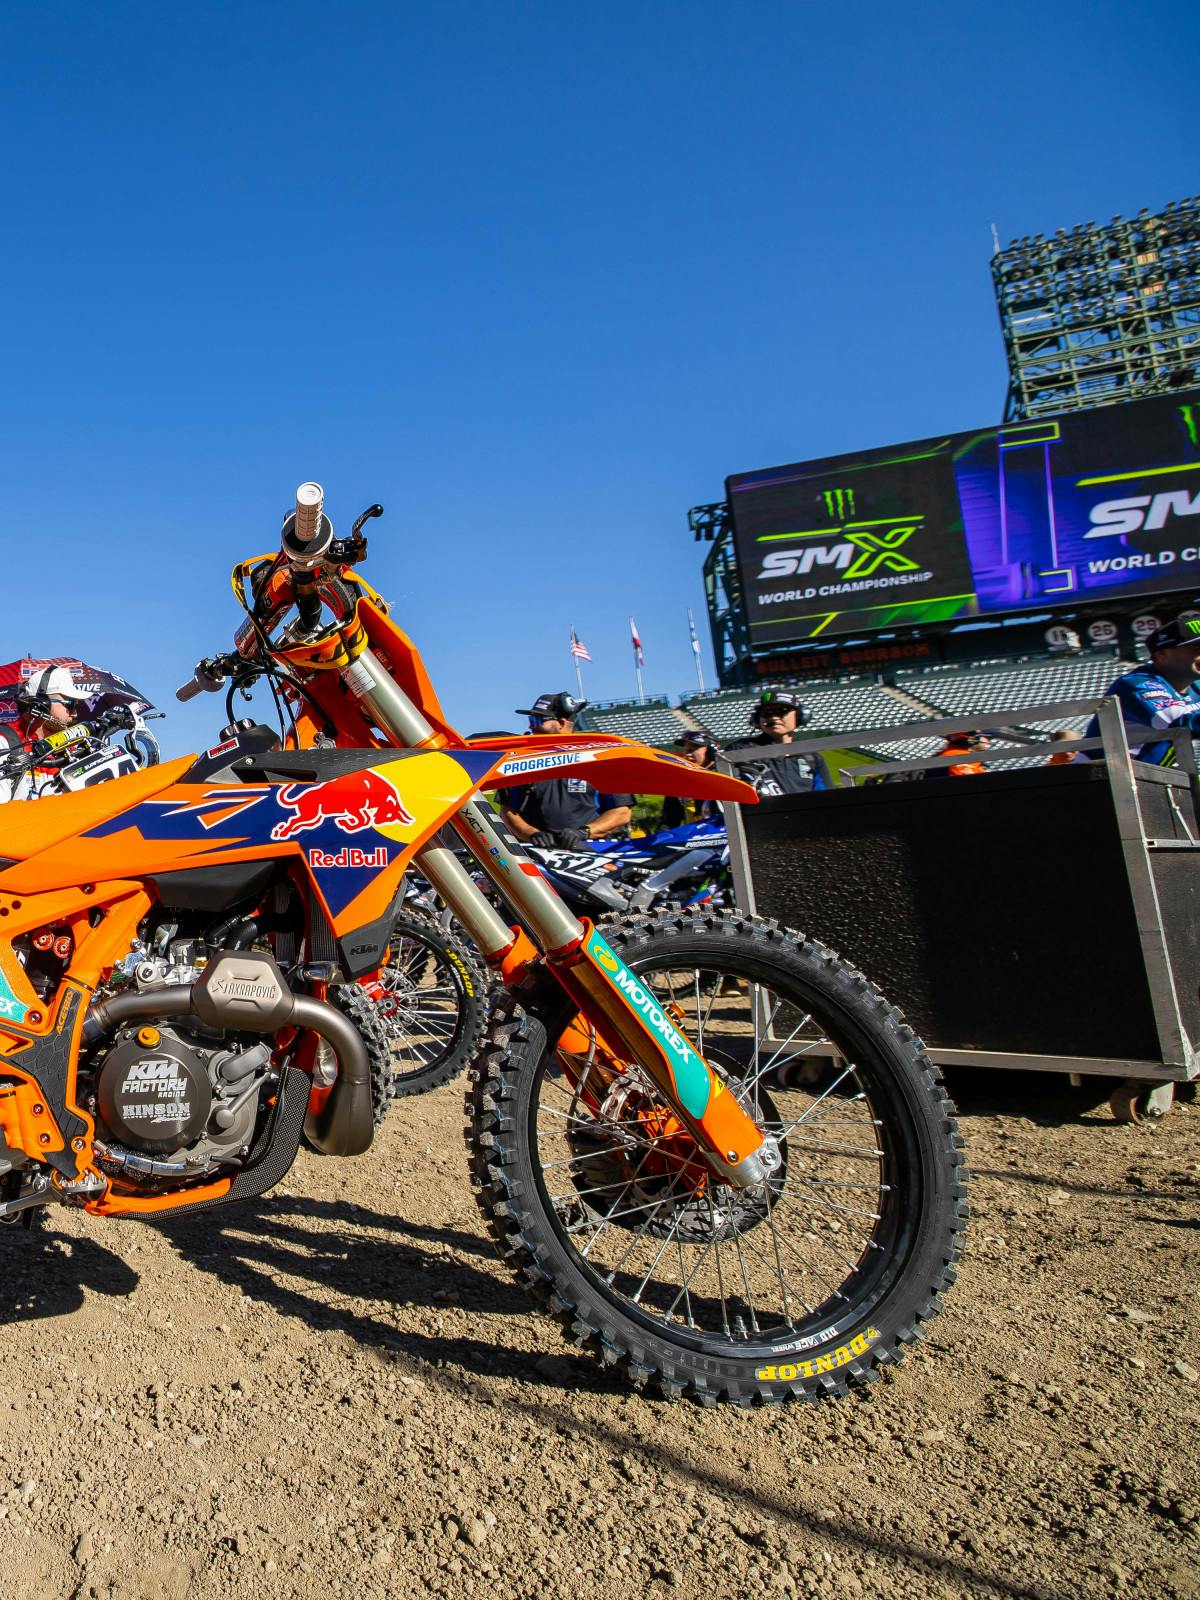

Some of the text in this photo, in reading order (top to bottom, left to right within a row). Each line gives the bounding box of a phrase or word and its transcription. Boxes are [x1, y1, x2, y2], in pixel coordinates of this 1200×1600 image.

[757, 526, 921, 579] SMX
[1088, 551, 1176, 573] WORLD
[758, 571, 933, 605] WORLD CHAMPIONSHIP
[503, 753, 582, 774] PROGRESSIVE
[462, 808, 486, 834] XACT
[309, 847, 388, 868] Red Bull
[350, 944, 379, 955] KTM
[615, 968, 694, 1065] MOTOREX
[127, 1060, 179, 1080] KTM
[121, 1078, 188, 1094] FACTORY
[122, 1102, 191, 1117] HINSON
[755, 1333, 870, 1380] DUNLOP
